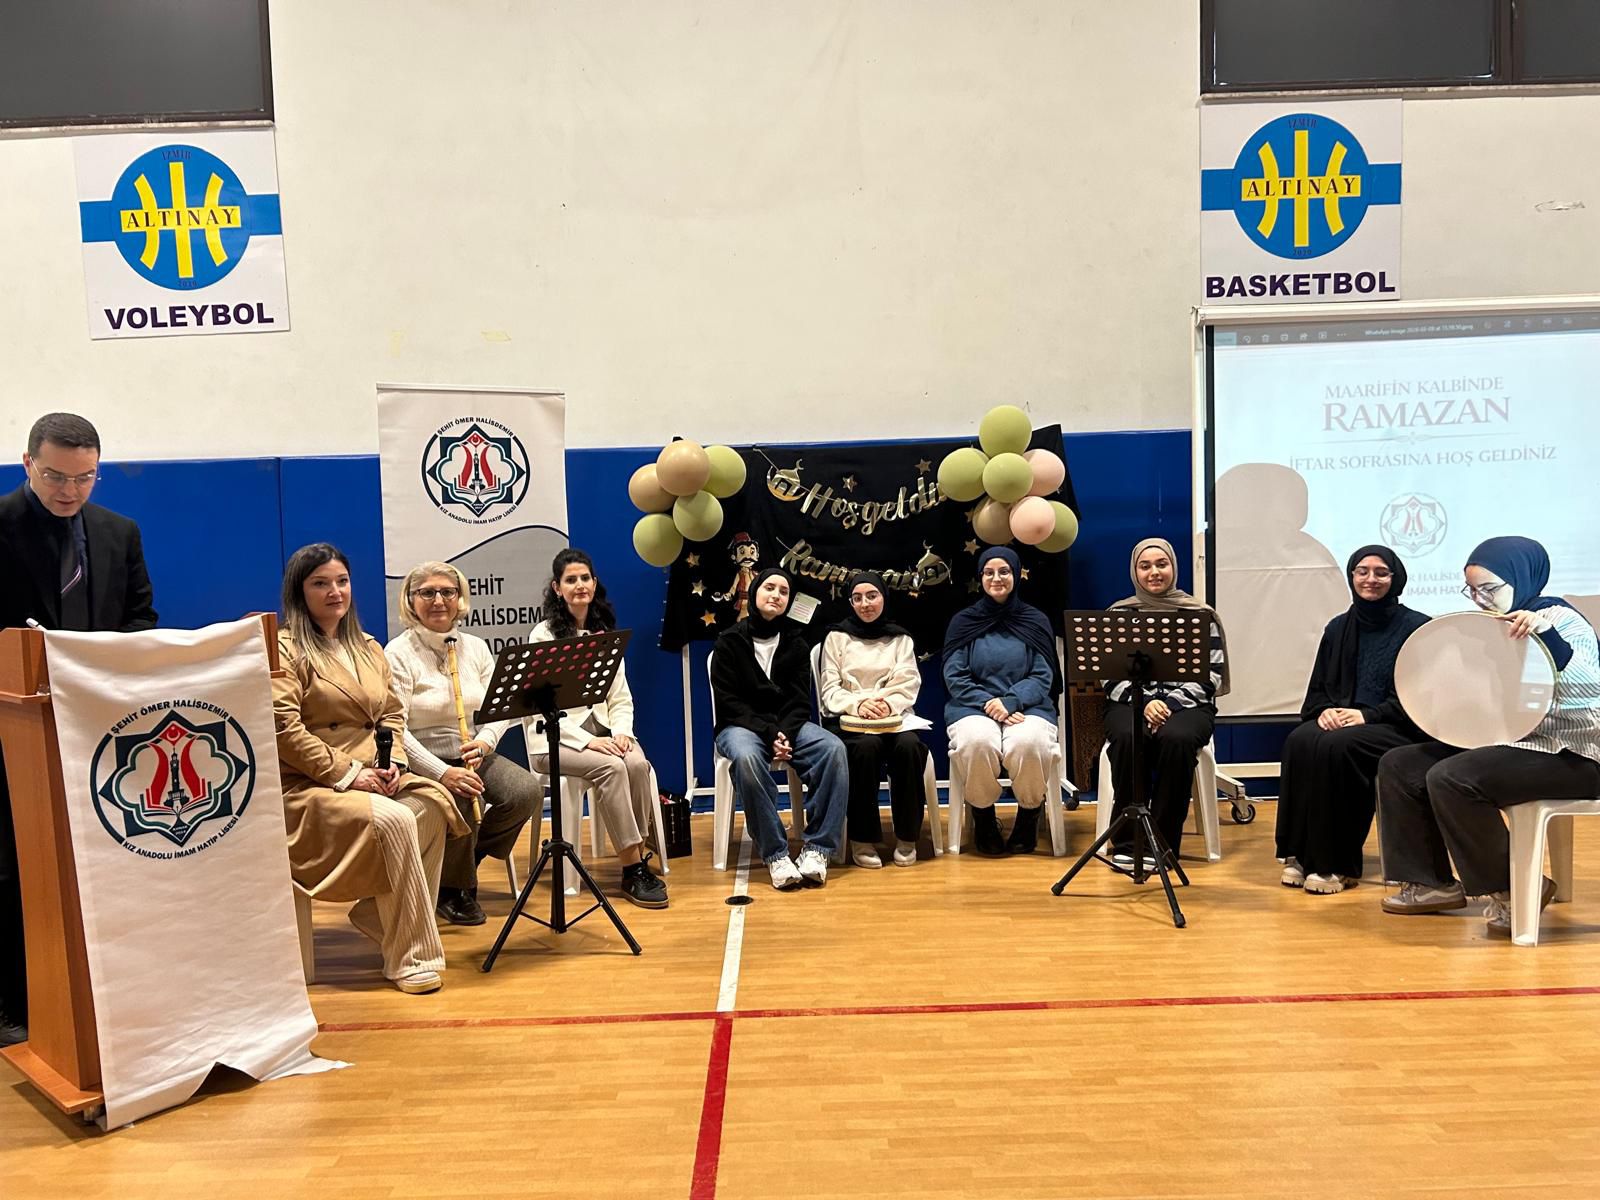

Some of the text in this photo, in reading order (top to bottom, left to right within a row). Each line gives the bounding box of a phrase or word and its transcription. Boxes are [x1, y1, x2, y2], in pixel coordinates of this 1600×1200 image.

[1247, 177, 1356, 197] ALTINAY
[126, 208, 236, 228] ALTINAY
[1206, 271, 1395, 298] BASKETBOL
[104, 302, 275, 330] VOLEYBOL
[1325, 375, 1504, 399] MAARİFİN KALBİNDE
[454, 416, 475, 425] ÖMER
[476, 417, 514, 437] HALİSDEMİR
[1322, 396, 1512, 432] RAMAZAN
[1340, 452, 1432, 470] SOFRASINA
[1436, 450, 1474, 467] HOŞ
[1478, 443, 1557, 463] GELDİNİZ
[467, 573, 505, 596] EHİT
[111, 698, 229, 734] ŞEHİT ÖMER HALİSDEMİR
[122, 816, 239, 860] KIZ ANADOLU İMAM HATİP LİSESİ
